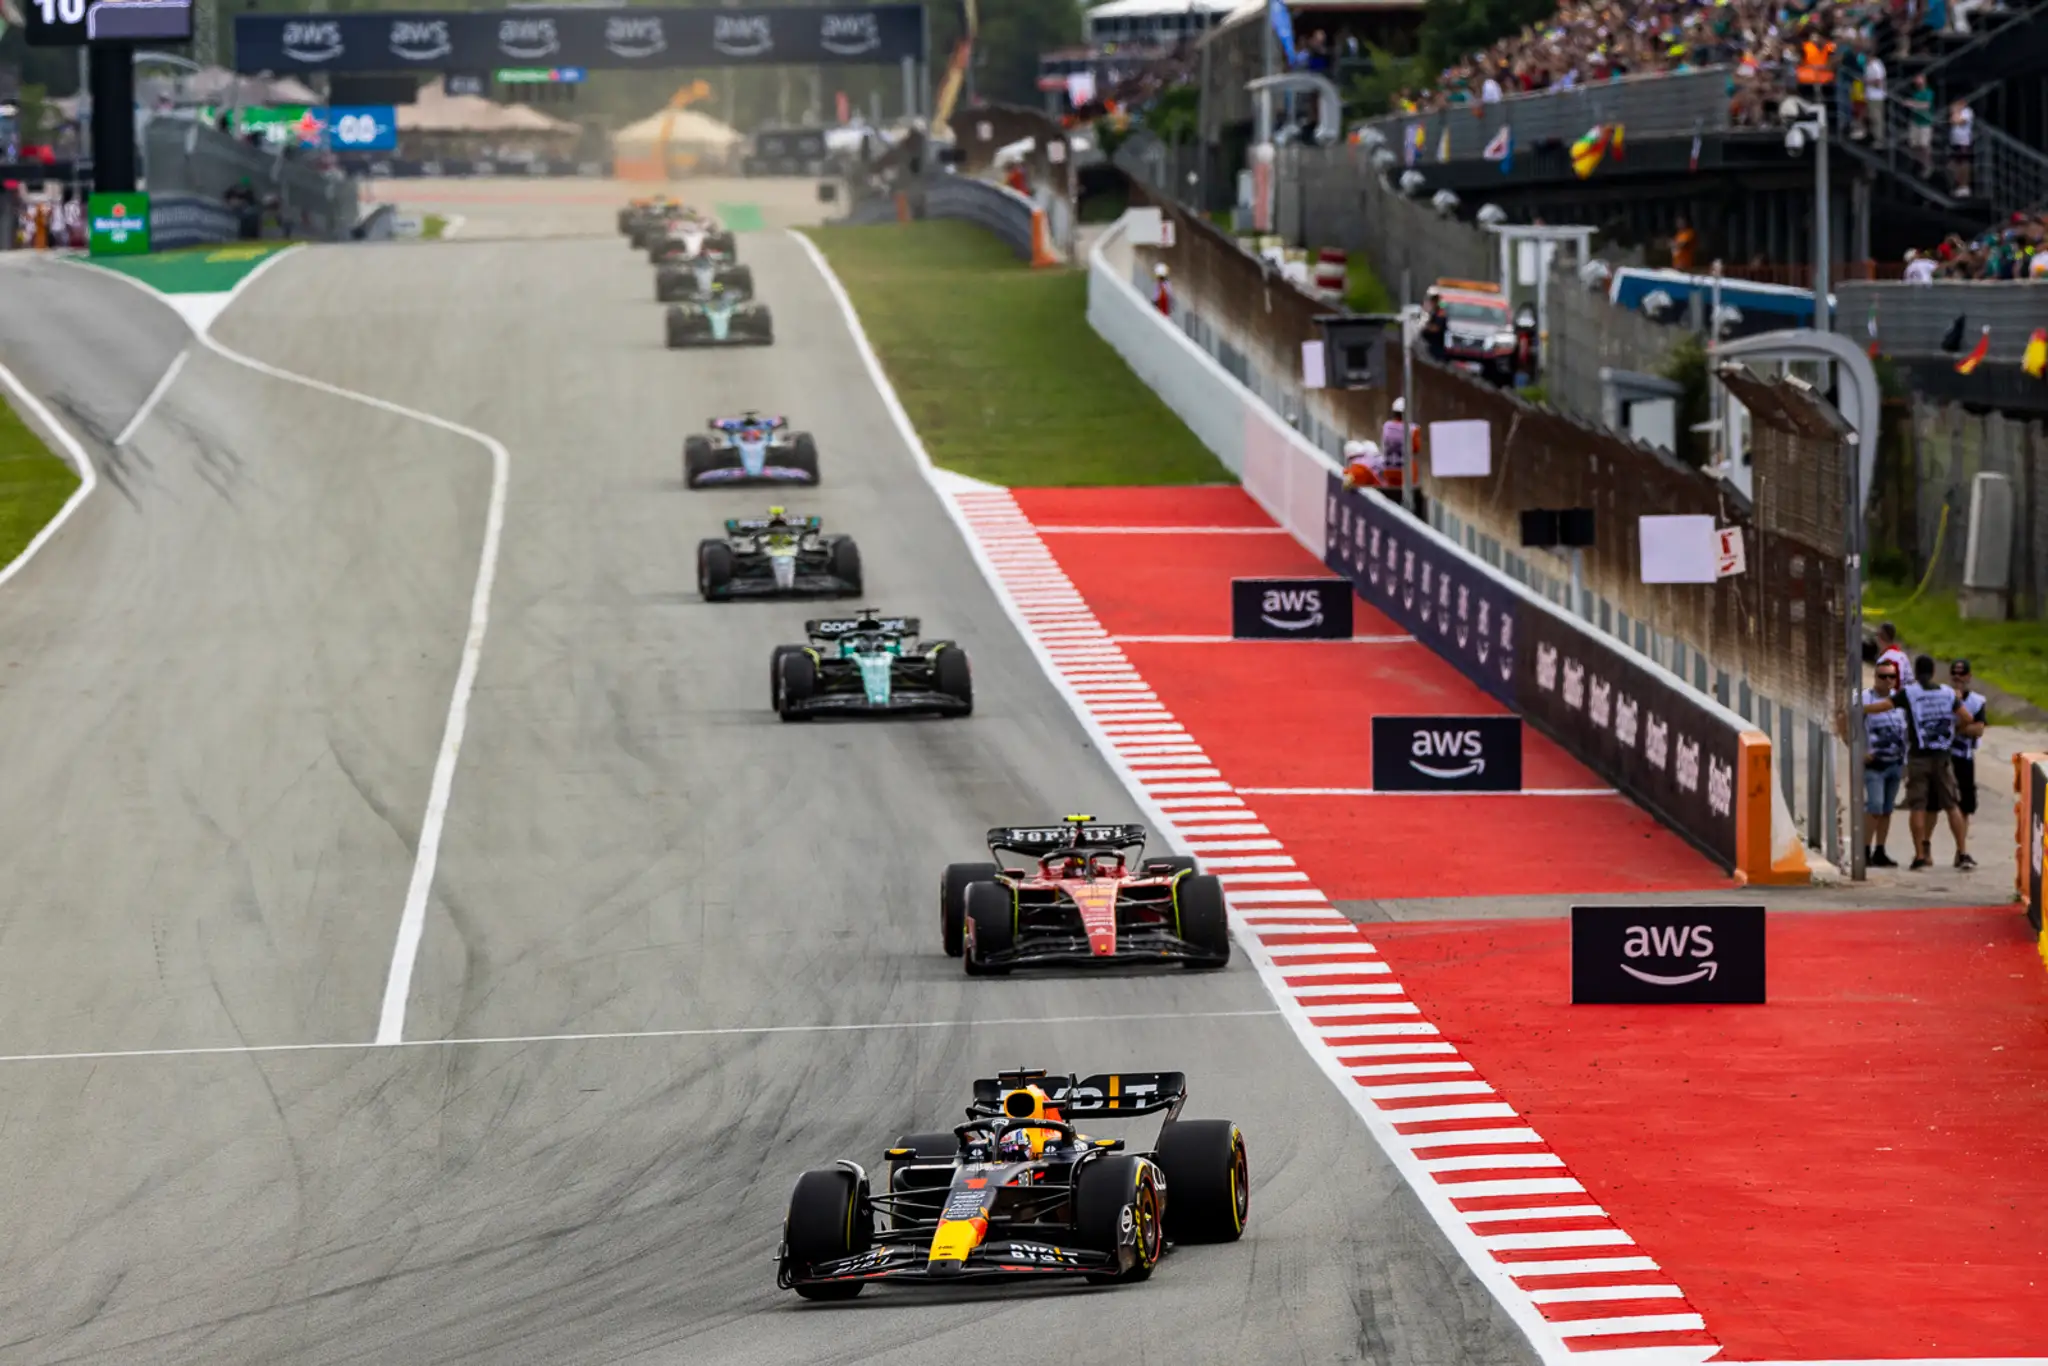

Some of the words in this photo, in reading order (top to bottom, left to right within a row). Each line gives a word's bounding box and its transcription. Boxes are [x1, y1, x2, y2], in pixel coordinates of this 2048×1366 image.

[283, 21, 340, 44] aws
[390, 20, 450, 43] aws
[499, 18, 560, 42] aws
[606, 17, 665, 40] aws
[714, 15, 771, 39] aws
[820, 13, 877, 37] aws
[1262, 590, 1322, 612] aws
[1411, 730, 1482, 757] aws
[1624, 925, 1715, 958] aws
